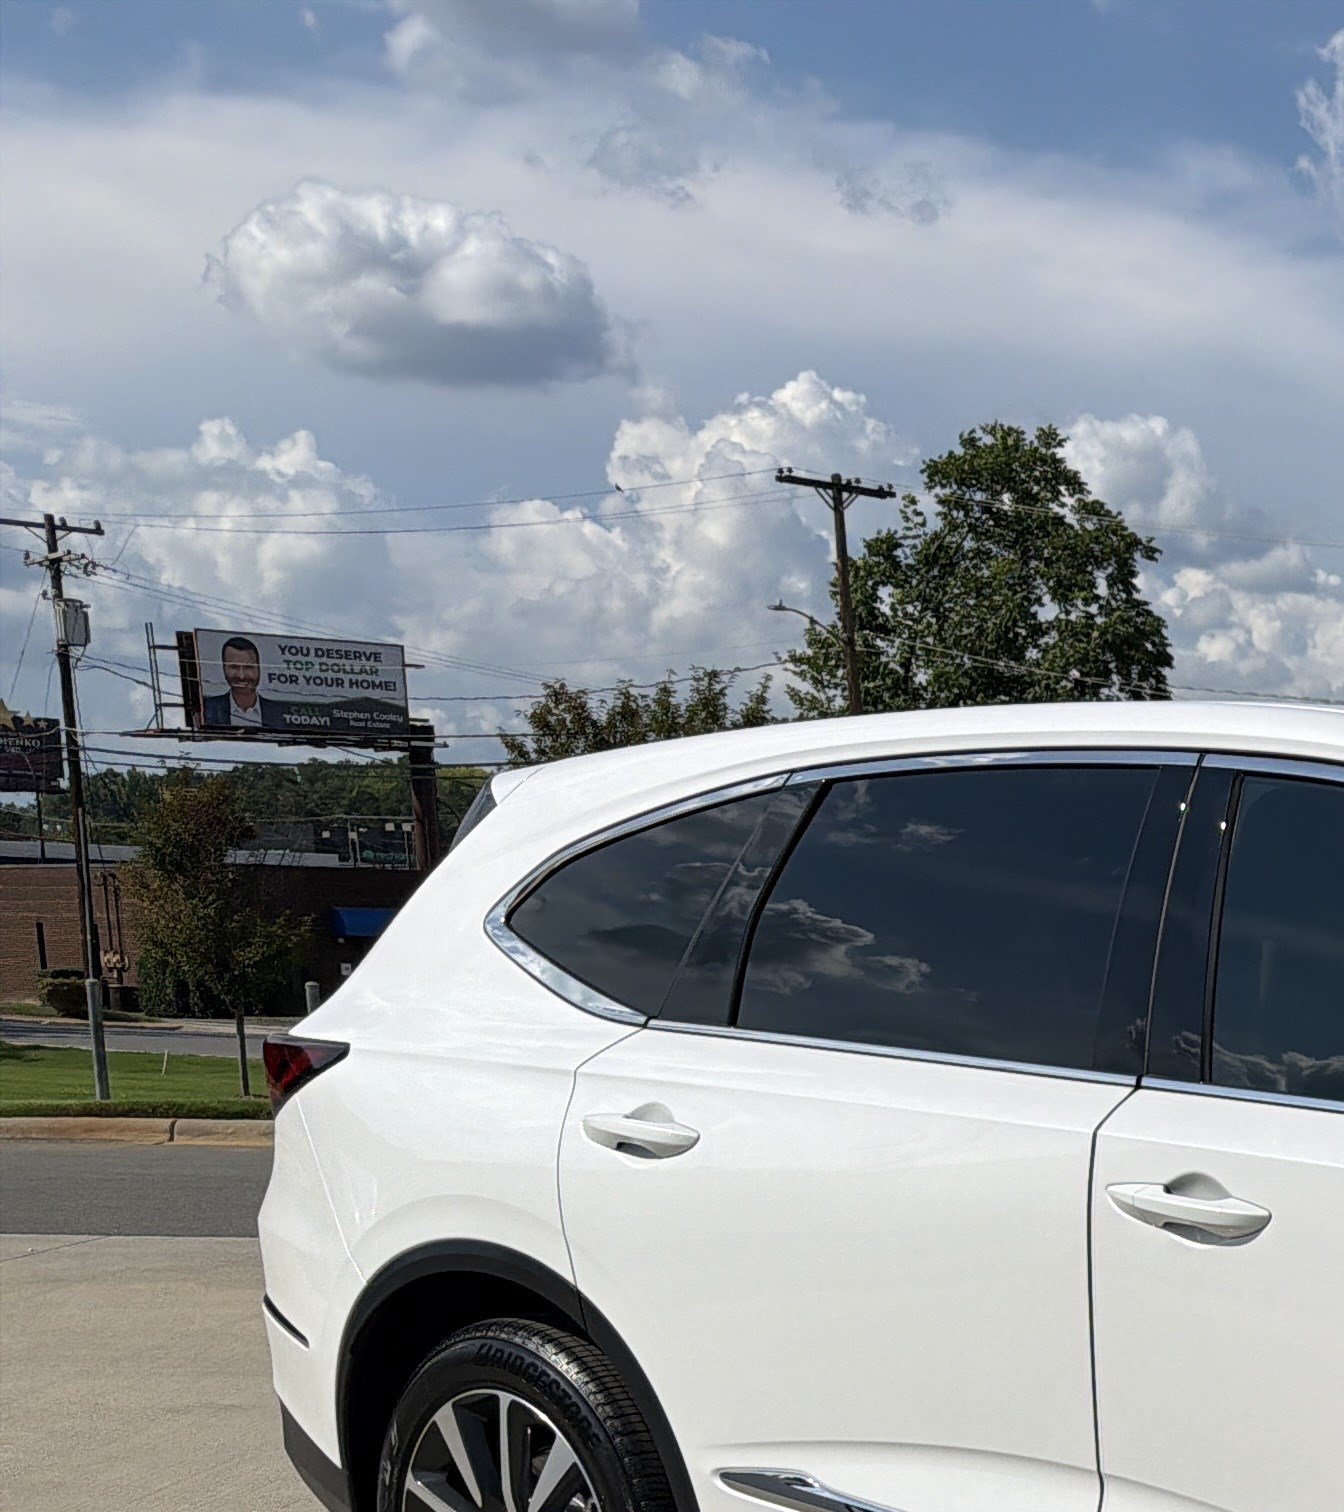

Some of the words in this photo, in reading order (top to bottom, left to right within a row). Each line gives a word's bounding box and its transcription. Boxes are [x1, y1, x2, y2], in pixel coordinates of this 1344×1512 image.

[277, 644, 311, 658] YOU
[314, 647, 382, 663] DESERVE
[283, 659, 315, 672] TOP
[319, 662, 379, 676] DOLLAR
[267, 673, 299, 685] FOR
[303, 675, 344, 689] YOUR
[349, 679, 397, 692] HOME!
[283, 714, 330, 726] TODAY!
[332, 709, 371, 721] Stephen
